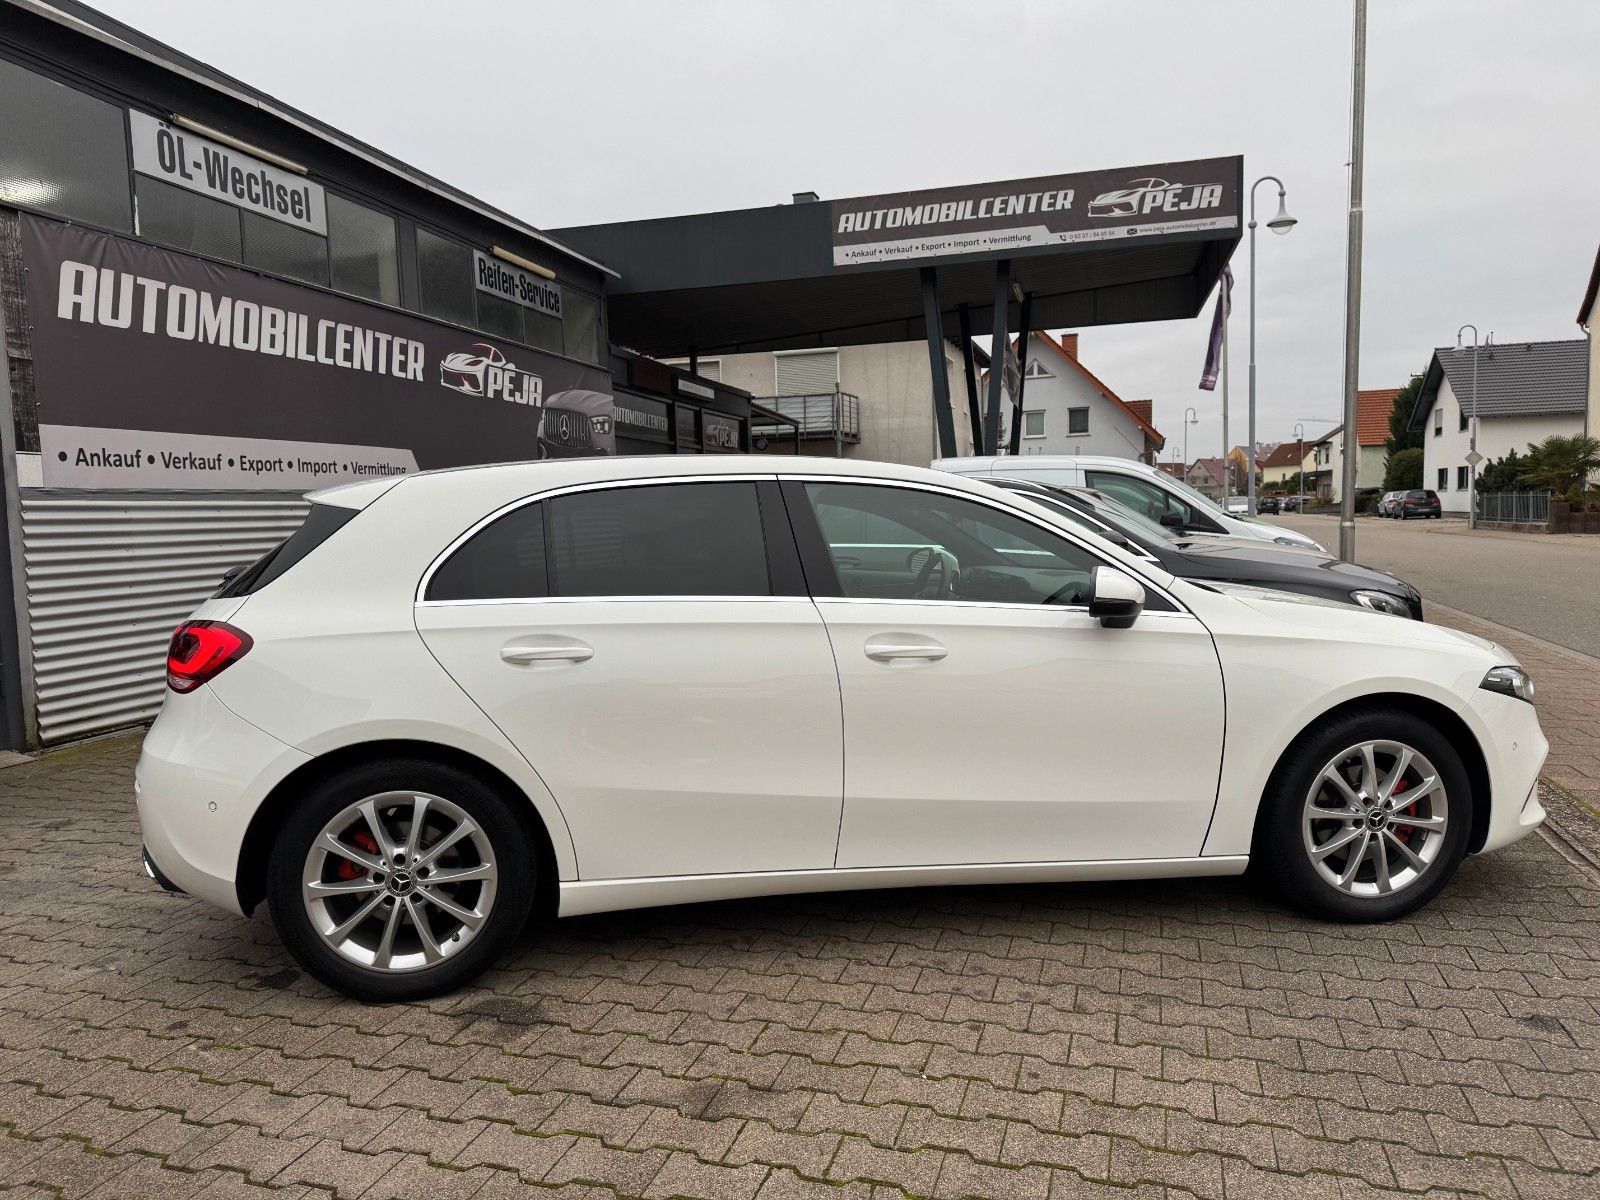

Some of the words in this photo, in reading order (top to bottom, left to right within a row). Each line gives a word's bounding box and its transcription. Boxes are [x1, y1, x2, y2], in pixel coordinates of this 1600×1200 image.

[156, 121, 312, 223] ÖL-Wechsel
[838, 189, 1075, 233] AUTOMOBILCENTER
[1142, 185, 1223, 214] PEJA
[851, 248, 877, 258] Ankauf
[884, 244, 913, 255] Verkauf
[921, 241, 946, 252] Export
[953, 238, 980, 249] Import
[988, 233, 1032, 245] Vermittlung
[478, 258, 560, 314] Reifen-Service
[57, 260, 426, 382] AUTOMOBILCENTER
[487, 365, 543, 408] PEJA
[75, 447, 142, 468] Ankauf
[160, 450, 222, 471] Verkauf
[239, 454, 284, 475] Export
[297, 457, 338, 476] Import
[351, 461, 407, 476] Vermittlung
